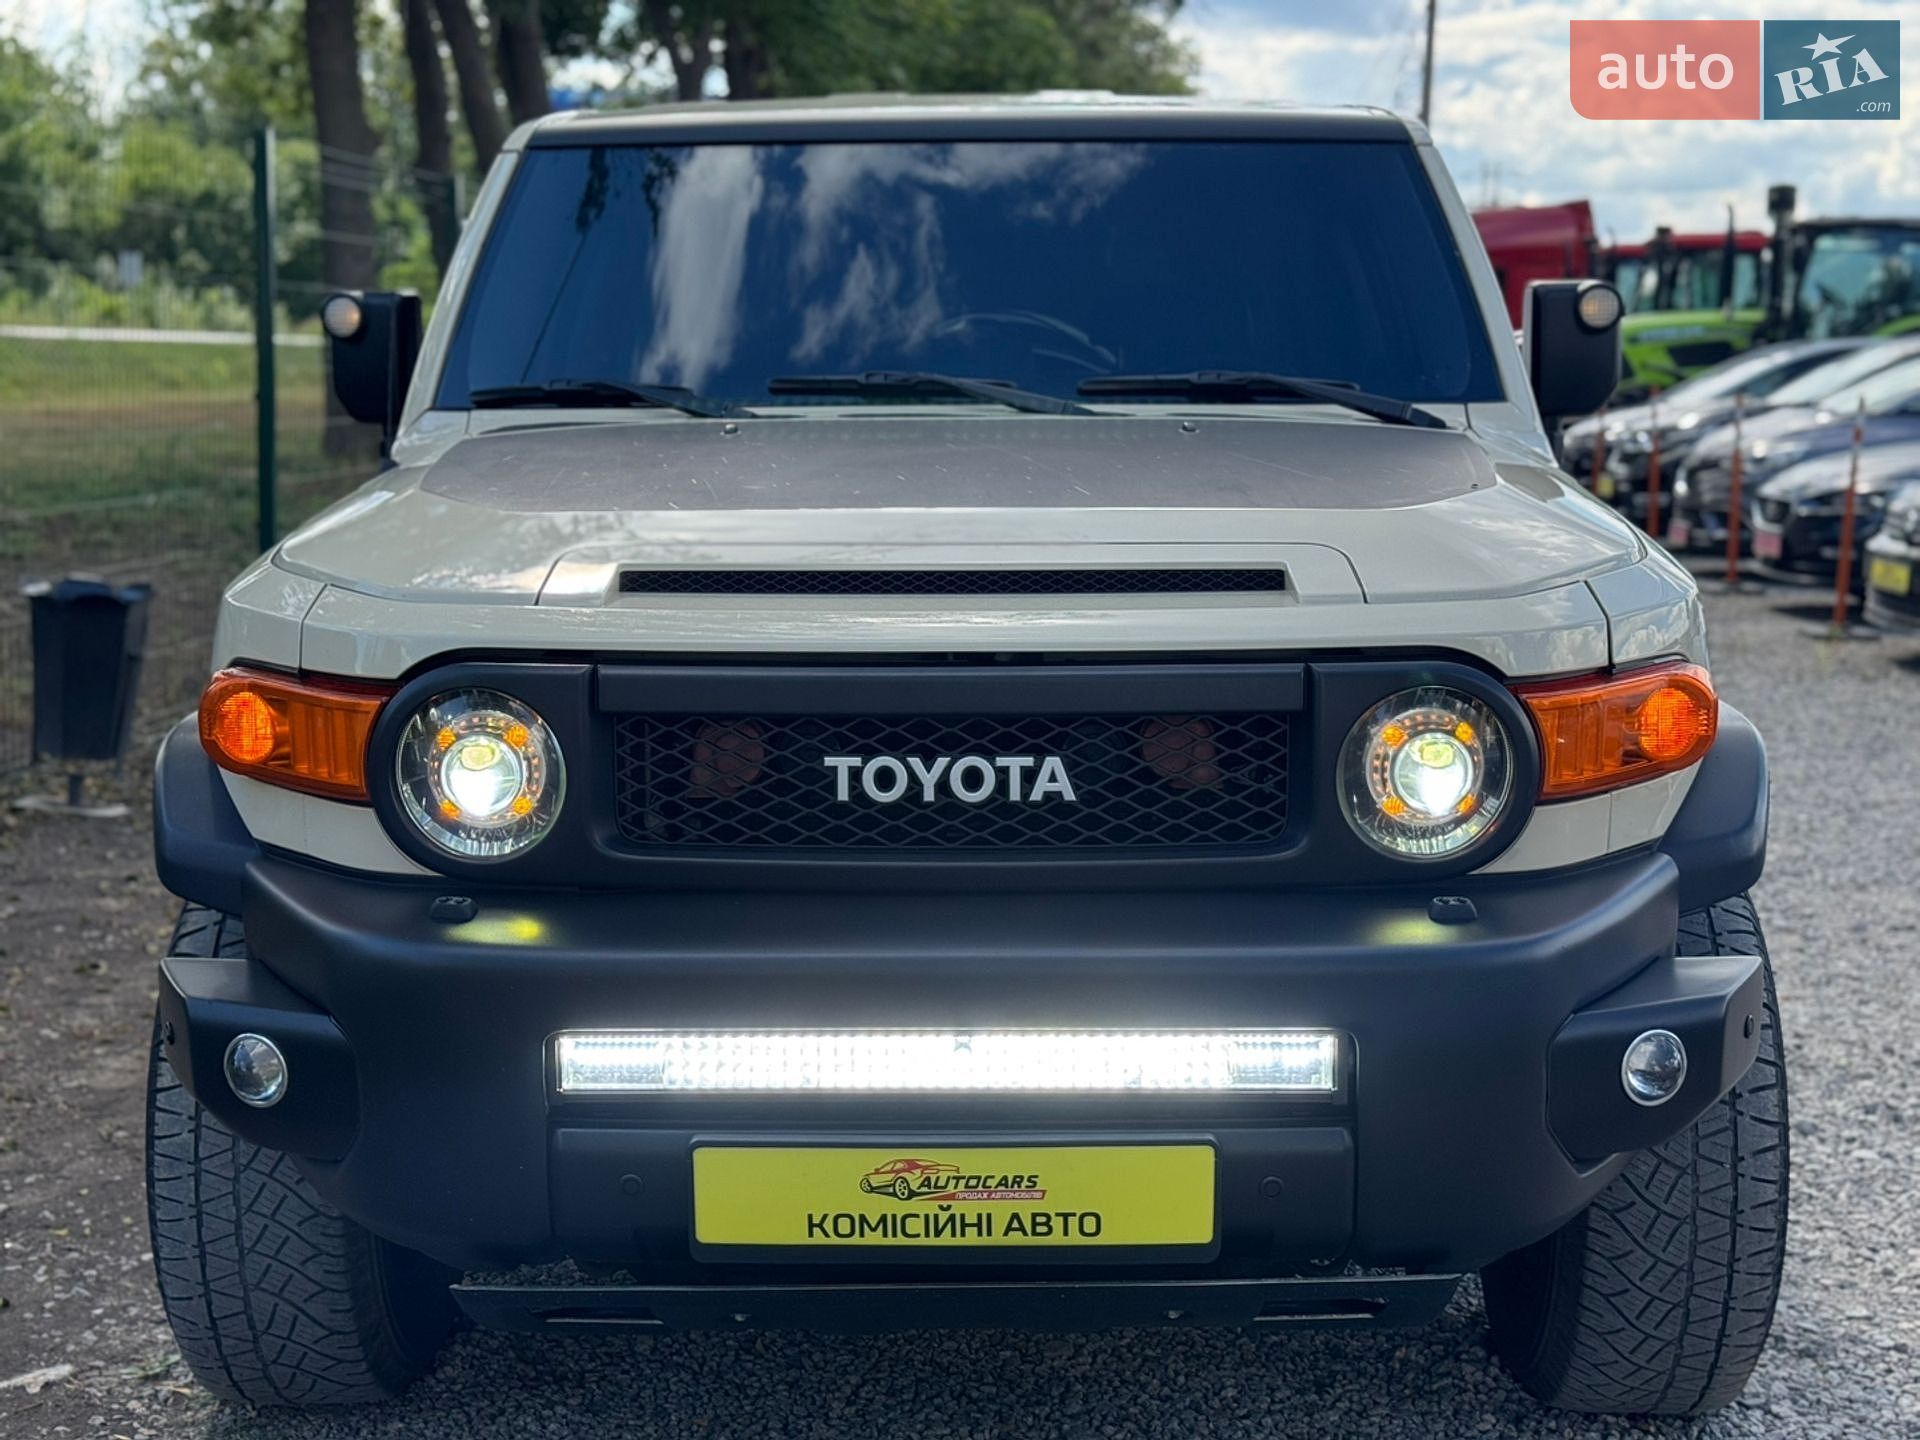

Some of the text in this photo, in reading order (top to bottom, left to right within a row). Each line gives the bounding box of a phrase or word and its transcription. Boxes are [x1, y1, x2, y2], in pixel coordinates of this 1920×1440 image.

[823, 756, 1077, 803] TOYOTA
[916, 1174, 1040, 1190] AUTOCARS
[806, 1204, 1103, 1239] КОМІСІЙНІ АВТО
